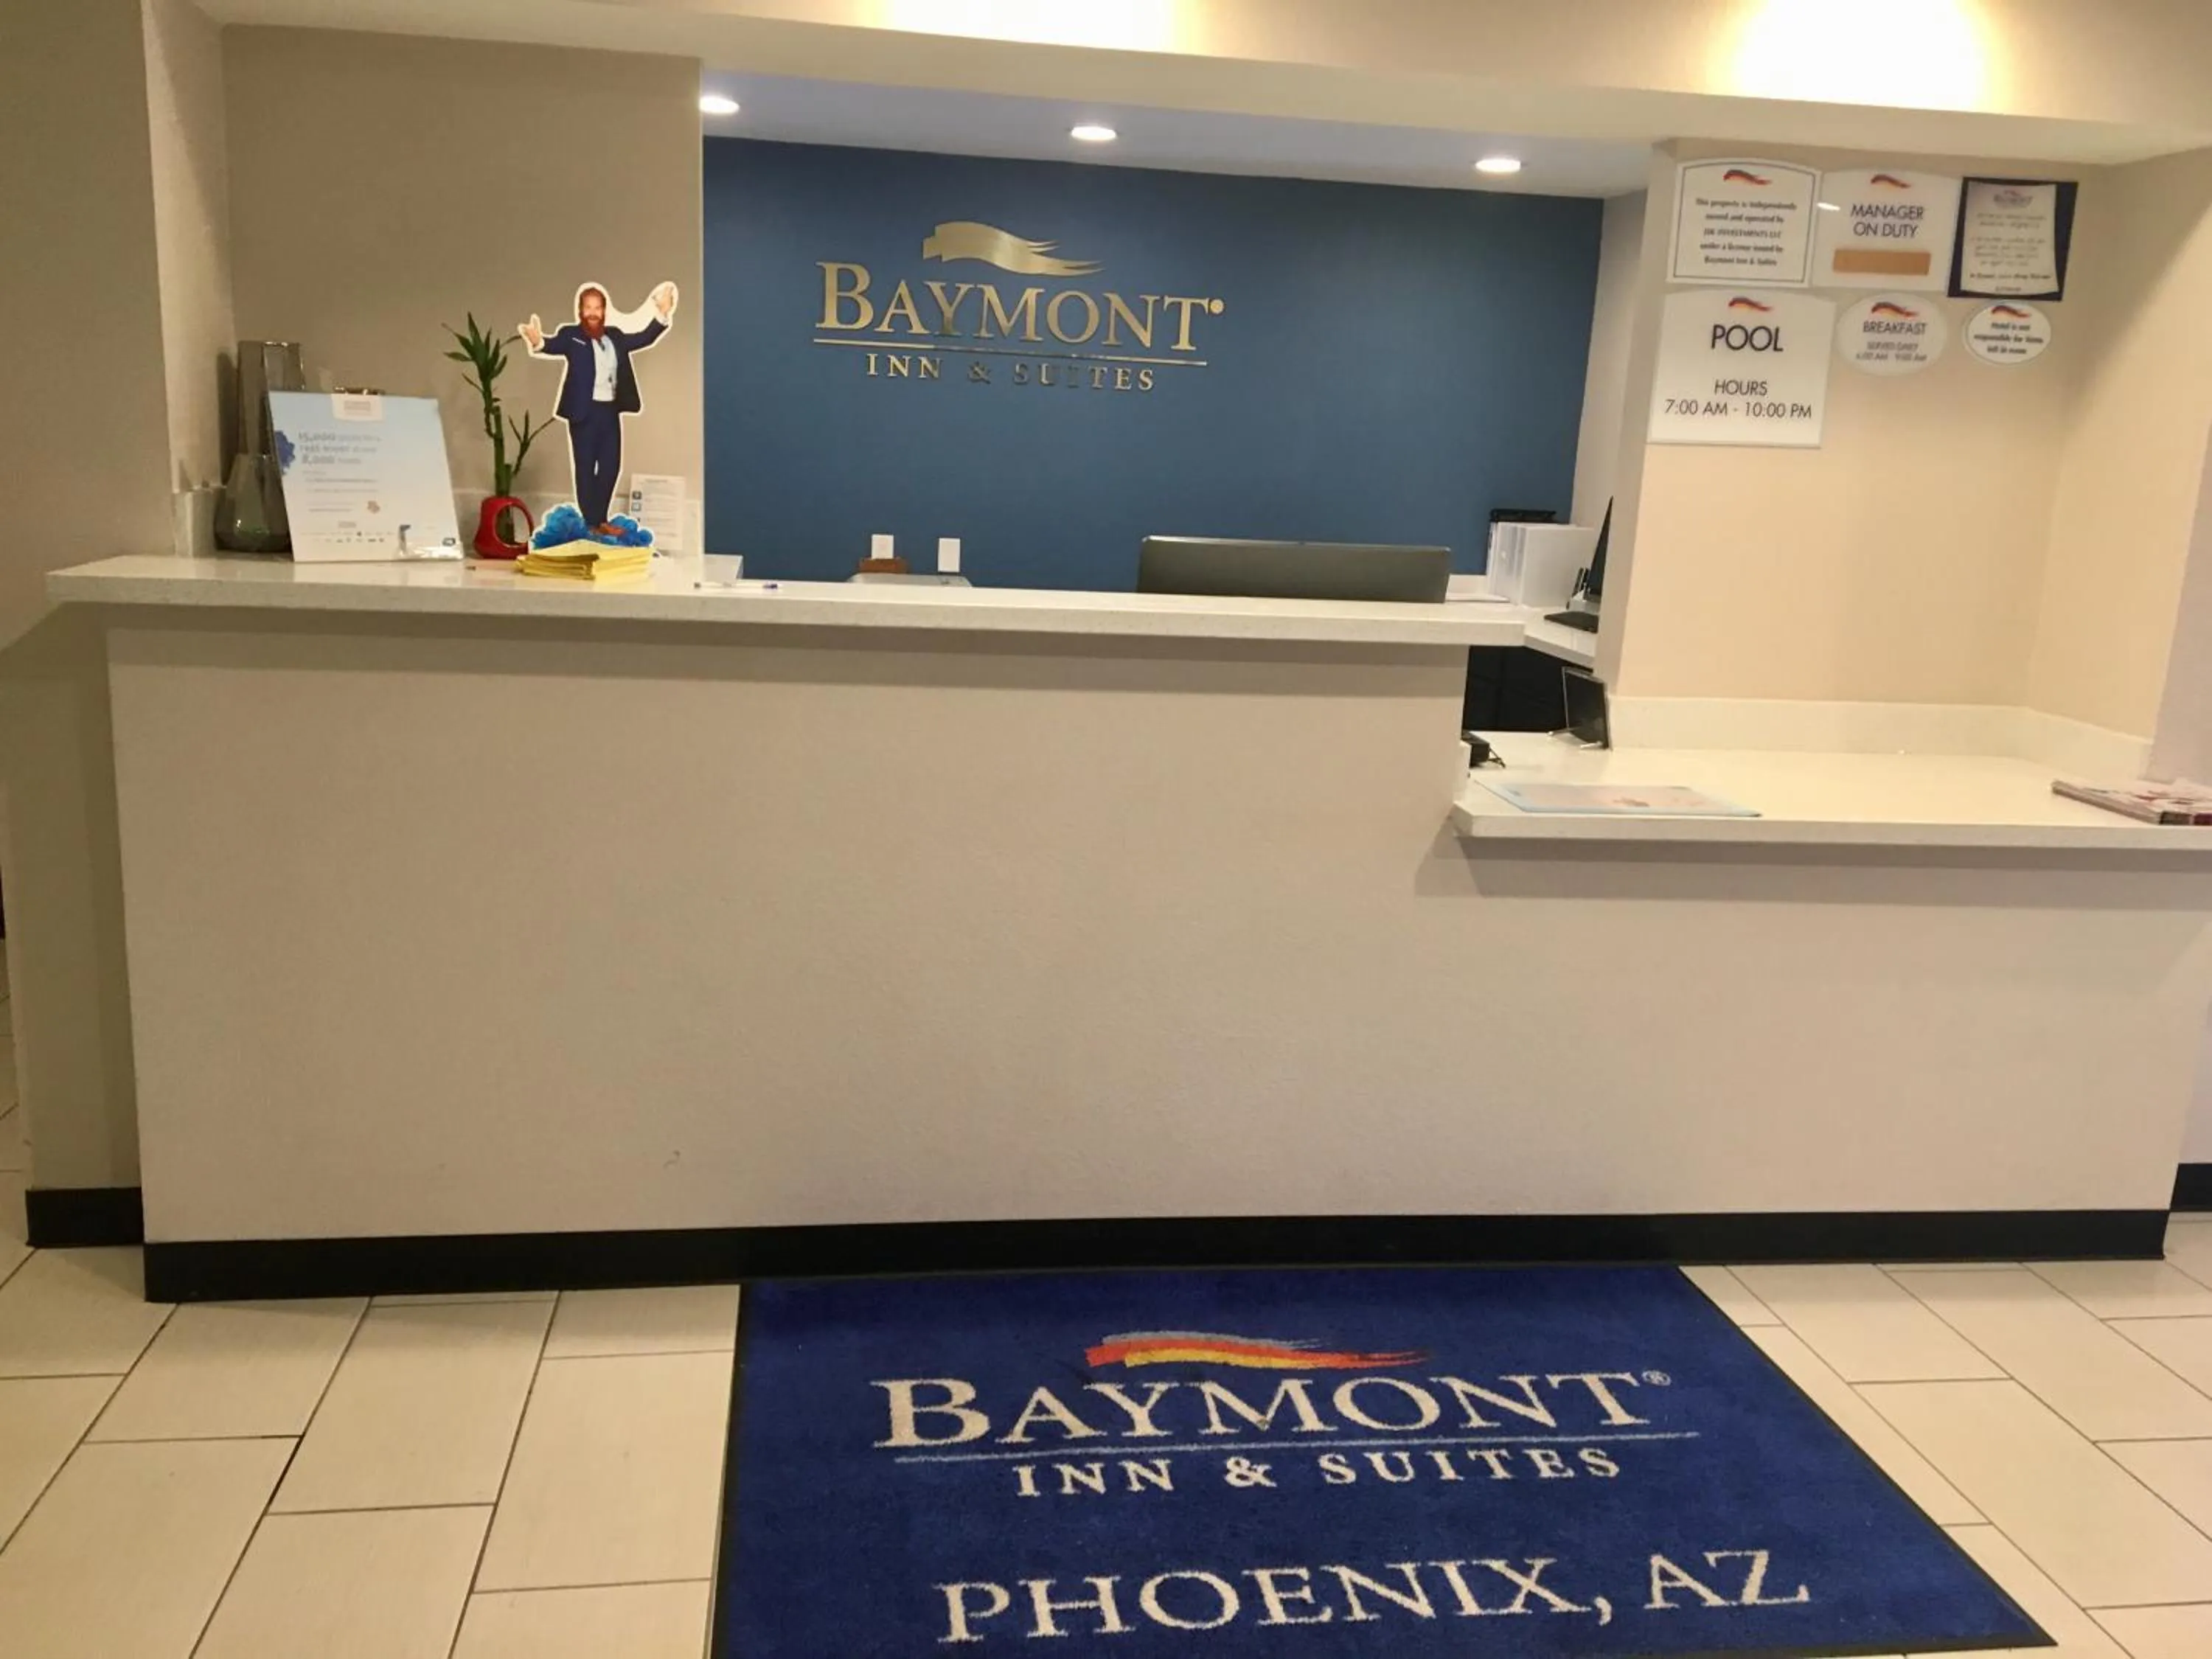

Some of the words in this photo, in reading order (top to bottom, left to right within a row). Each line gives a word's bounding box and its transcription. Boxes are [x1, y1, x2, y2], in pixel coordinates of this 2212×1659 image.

[1850, 204, 1924, 220] MANAGER
[1853, 222, 1878, 236] ON
[1882, 223, 1919, 237] DUTY
[814, 261, 1211, 351] BAYMONT
[1710, 324, 1784, 352] POOL
[1863, 321, 1927, 335] BREAKFAST
[866, 353, 942, 378] INN
[968, 361, 992, 384] &
[1012, 363, 1155, 391] SUITES
[1714, 379, 1767, 395] HOURS
[1665, 399, 1698, 415] 7:00
[1703, 401, 1728, 416] AM
[1745, 402, 1786, 417] 10:00
[1790, 403, 1812, 418] PM
[1013, 1460, 1175, 1498] INN
[1225, 1455, 1276, 1488] &
[1324, 1447, 1622, 1486] SUITES
[931, 1557, 1614, 1644] PHOENIX,
[1643, 1550, 1810, 1611] AZ
